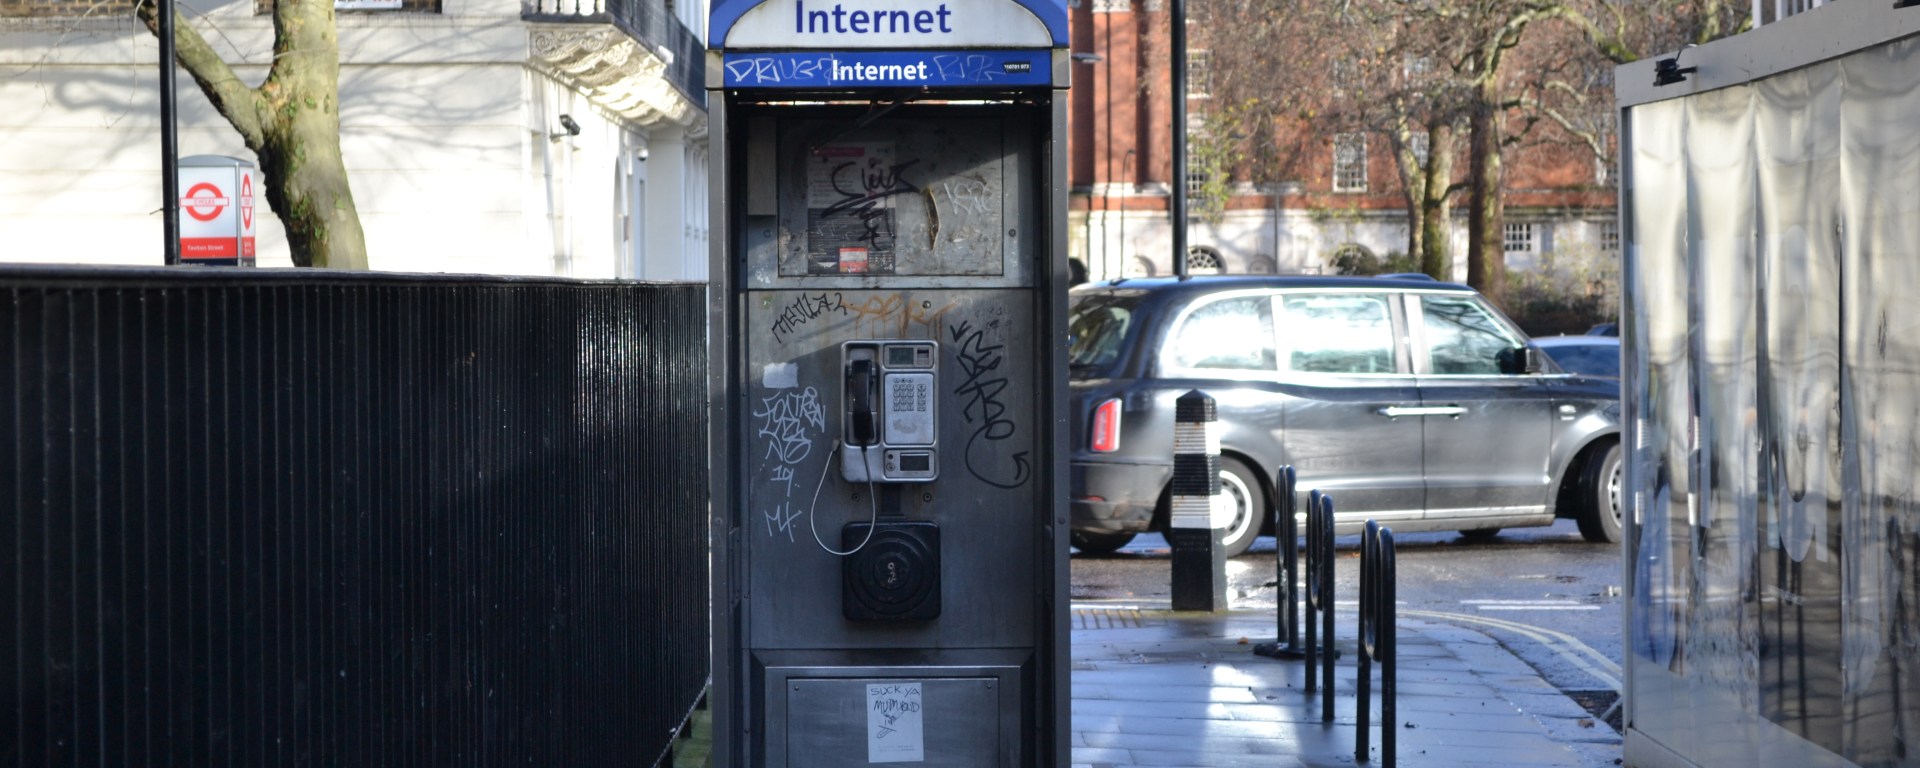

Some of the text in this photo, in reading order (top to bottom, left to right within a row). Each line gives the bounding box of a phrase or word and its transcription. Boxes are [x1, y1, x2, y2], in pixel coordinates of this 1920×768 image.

[796, 0, 952, 33] Internet
[832, 59, 928, 81] Internet
[870, 685, 921, 698] SUCK YA
